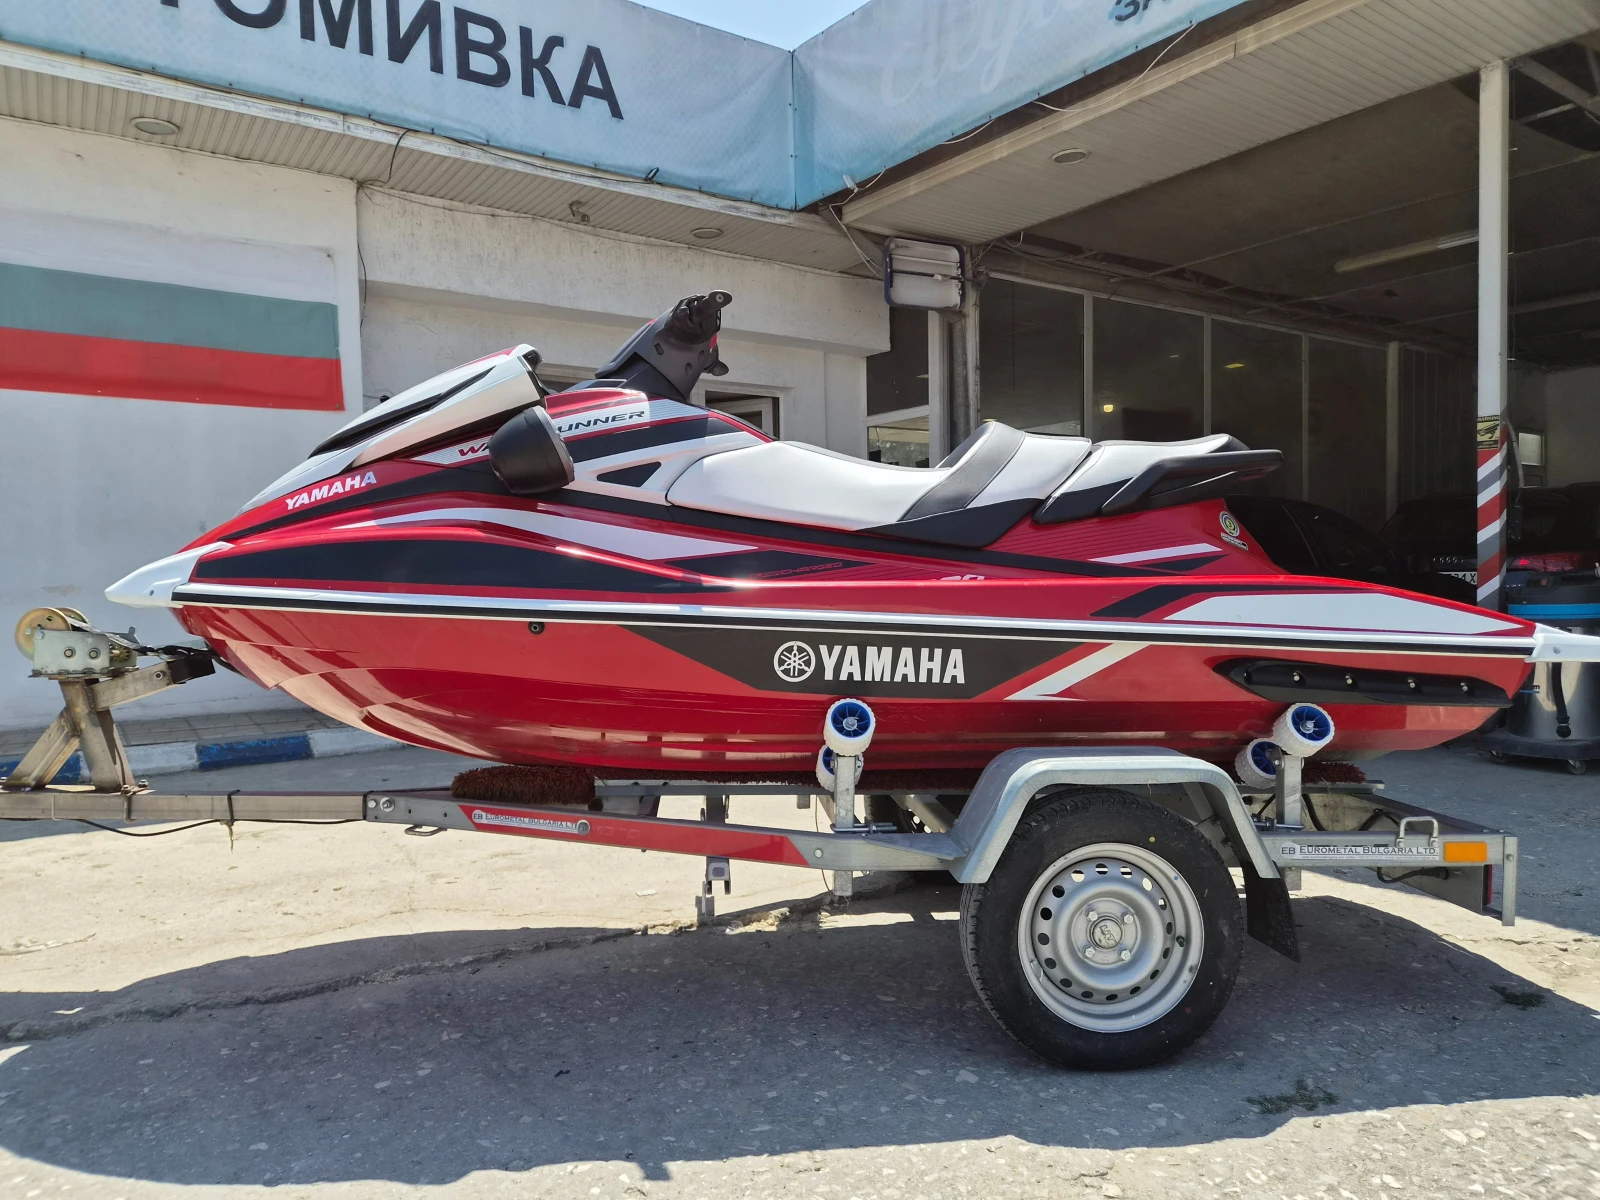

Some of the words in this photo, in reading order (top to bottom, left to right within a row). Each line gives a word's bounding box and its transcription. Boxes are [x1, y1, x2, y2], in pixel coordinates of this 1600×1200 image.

[285, 471, 377, 511] YAMAHA
[818, 644, 966, 684] YAMAHA
[485, 813, 527, 823] EUROMETAL
[528, 817, 563, 827] BULGARIA
[1281, 846, 1296, 855] EB
[1300, 845, 1360, 854] EUROMETAL
[1362, 846, 1414, 855] BULGARIA
[1416, 846, 1439, 855] LTD.
